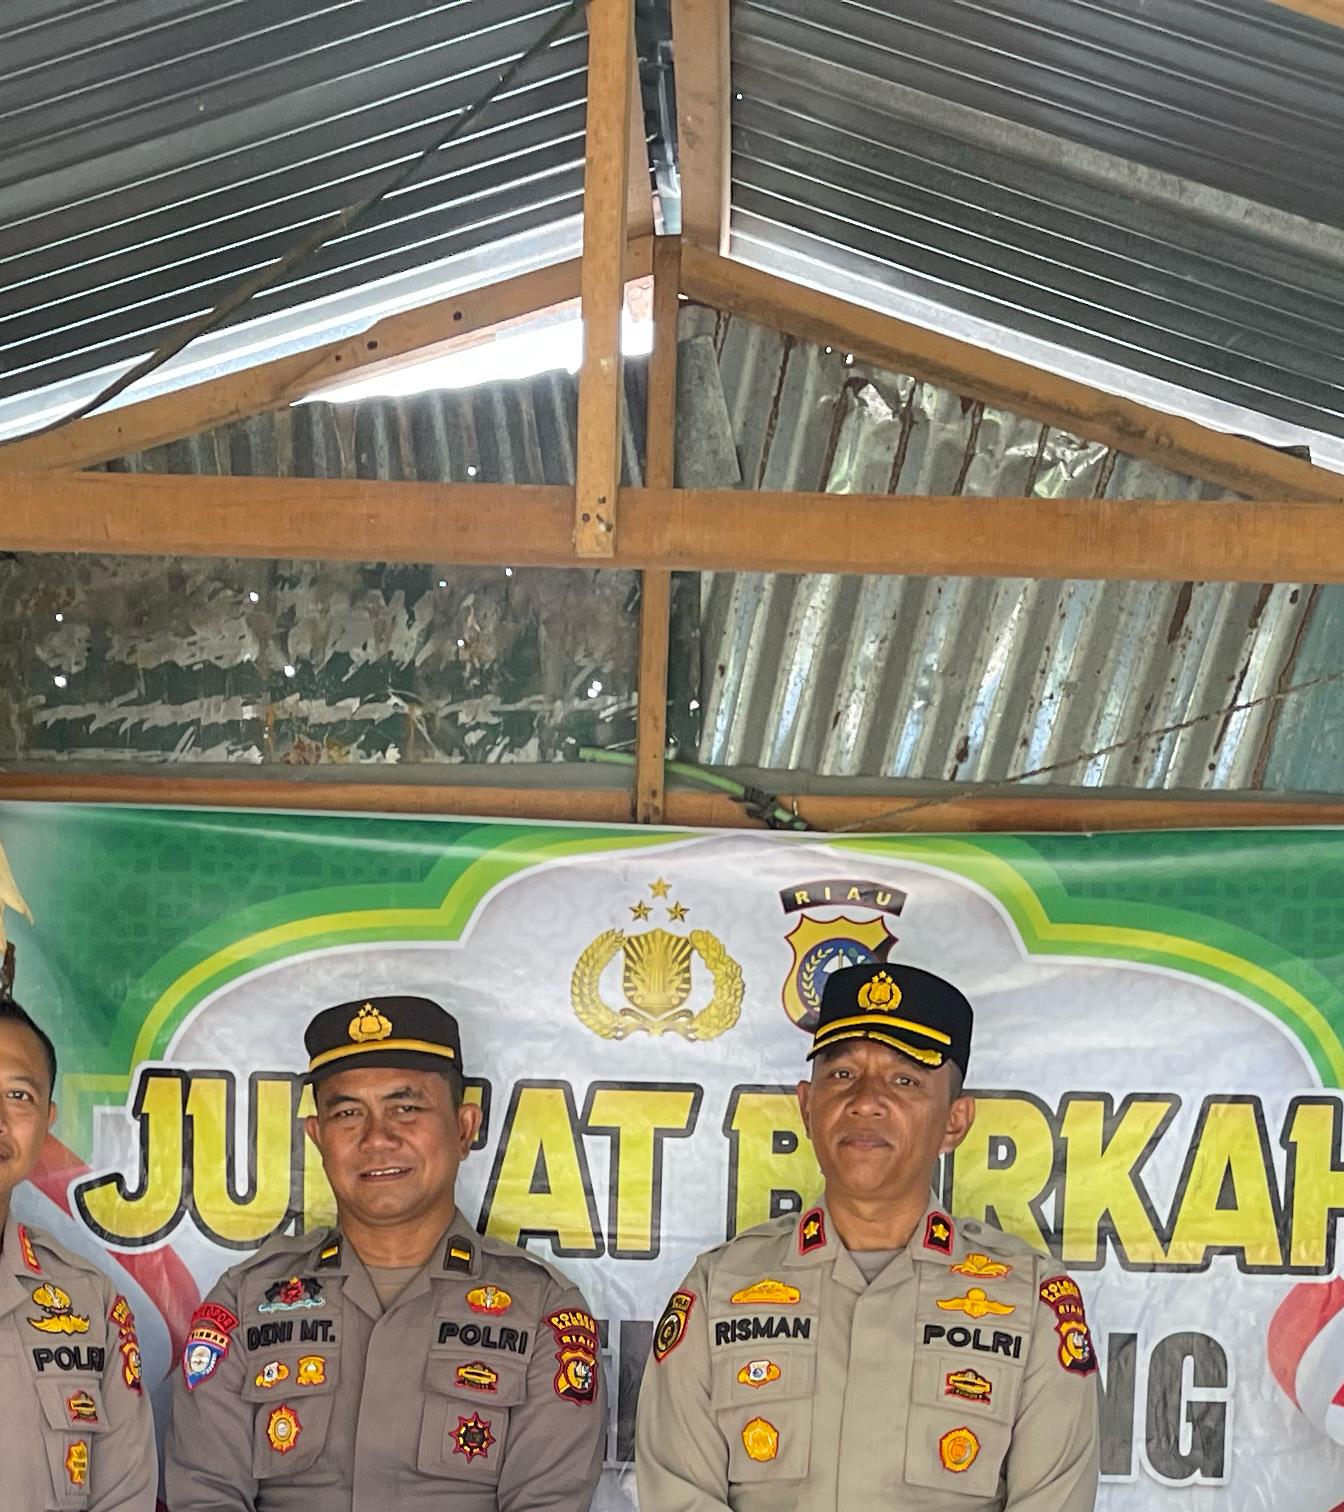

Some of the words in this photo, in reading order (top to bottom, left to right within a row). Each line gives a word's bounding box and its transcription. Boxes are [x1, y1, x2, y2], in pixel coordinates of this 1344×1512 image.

[794, 886, 892, 906] RIAU
[247, 1319, 293, 1351] DENI
[299, 1319, 336, 1343] MT.
[438, 1320, 529, 1355] POLRI
[715, 1317, 811, 1346] RISMAN
[923, 1323, 1023, 1359] POLRI
[32, 1346, 105, 1372] POLRI
